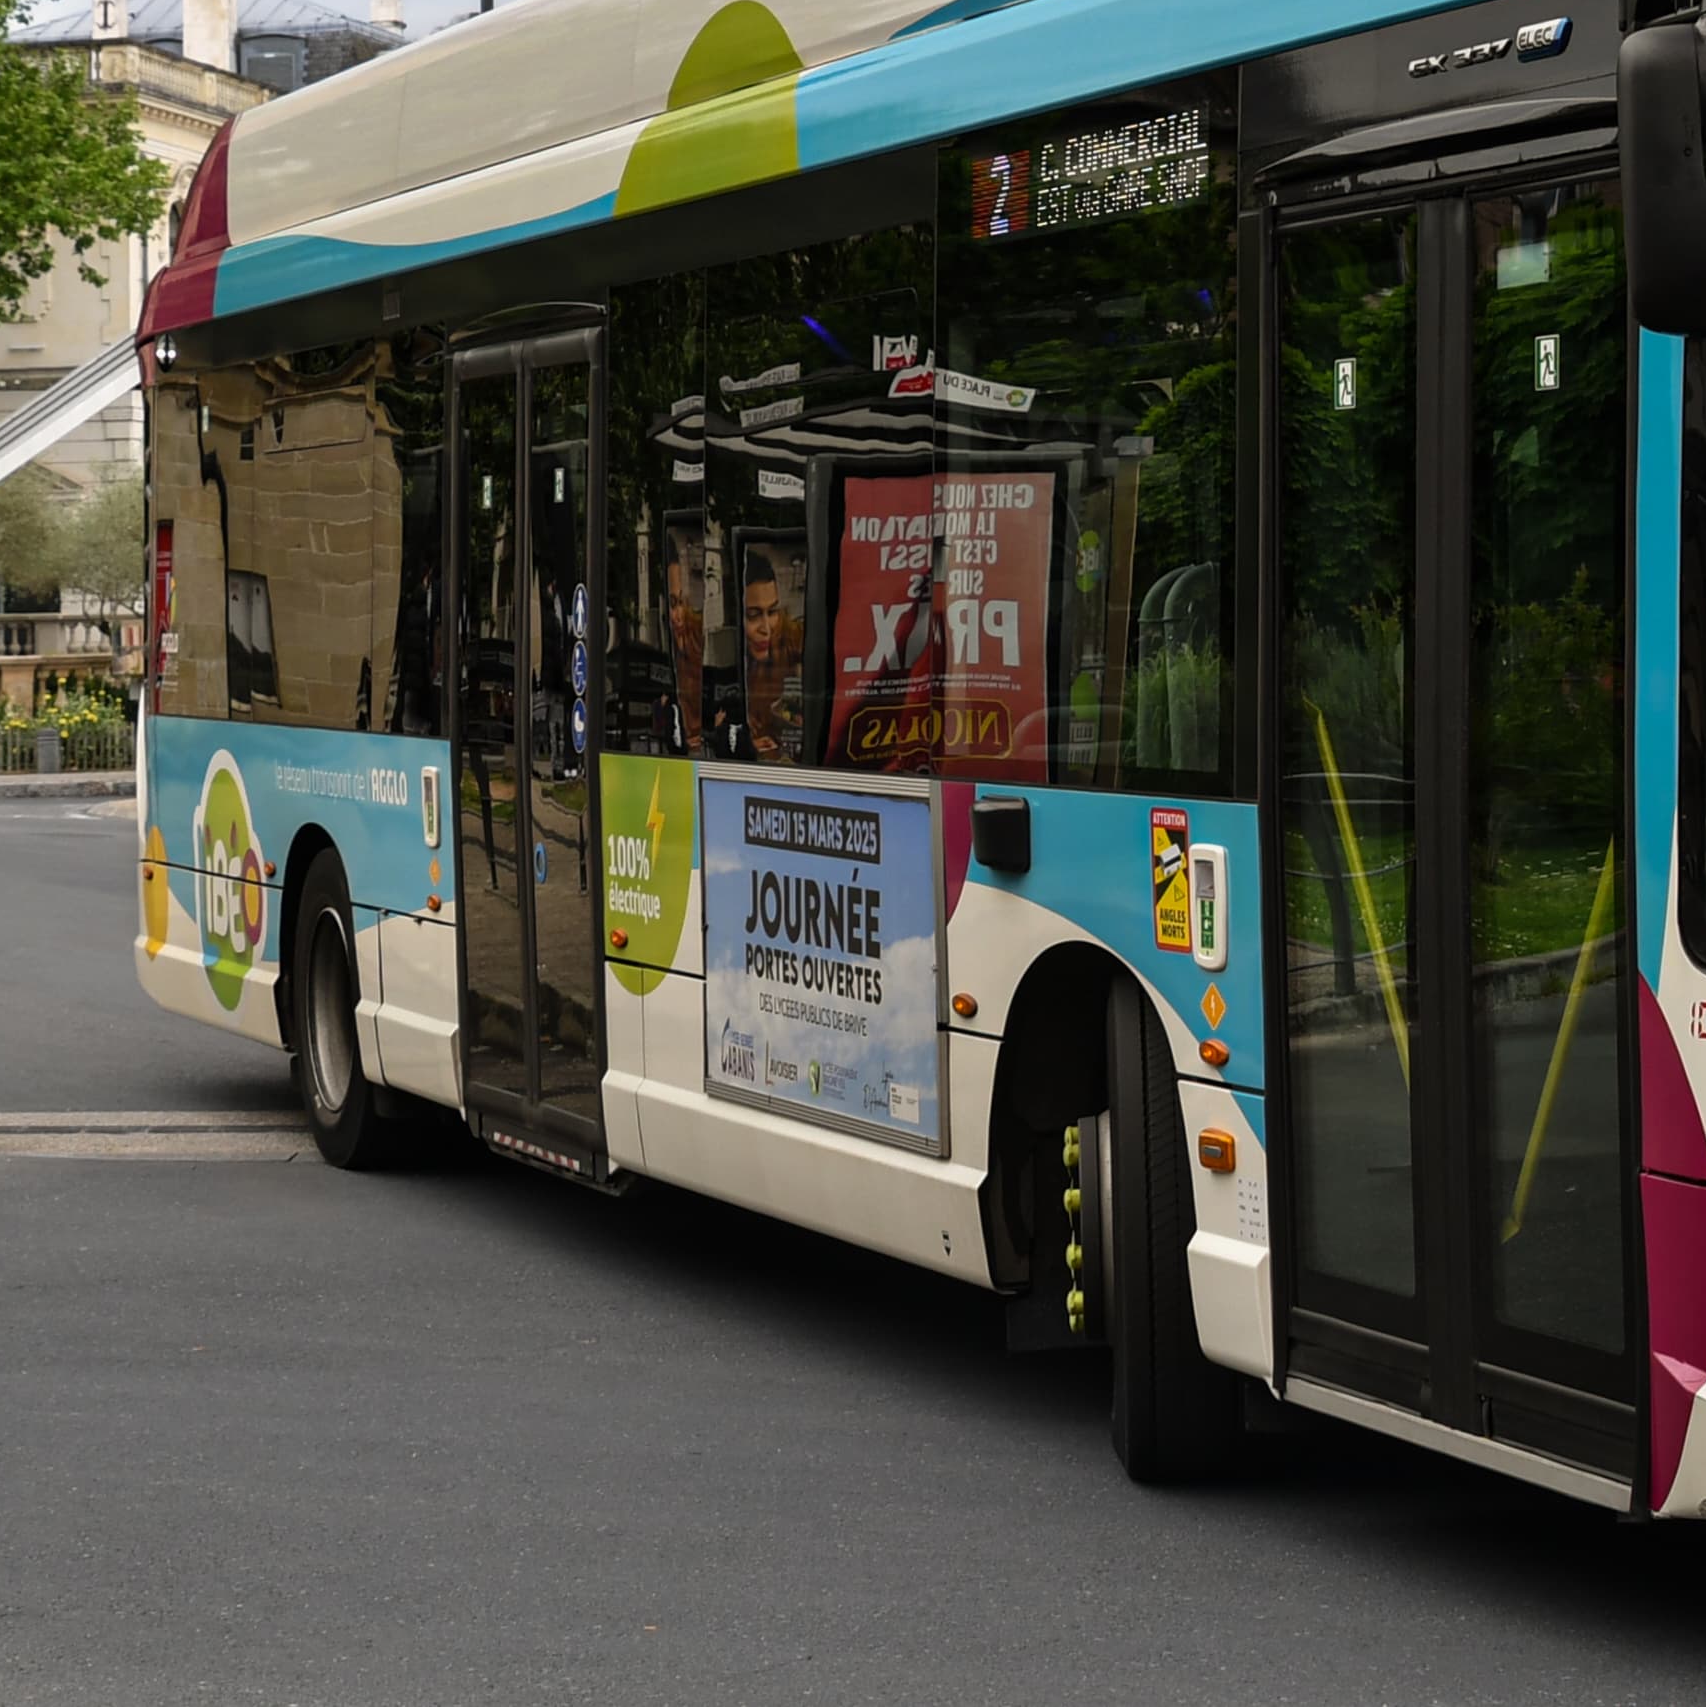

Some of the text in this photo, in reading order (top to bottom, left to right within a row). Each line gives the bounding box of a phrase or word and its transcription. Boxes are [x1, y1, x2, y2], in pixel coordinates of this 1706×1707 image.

[1408, 37, 1513, 78] GX 337
[1518, 26, 1552, 48] ELEC
[1064, 109, 1207, 176] COMMERCIAL
[990, 155, 1011, 236] 2
[1037, 155, 1209, 227] EST via GARE SNCF
[748, 805, 878, 856] SAMEDI 15 MARS 2025
[1153, 811, 1186, 827] ATTENTION
[608, 833, 650, 881] 100%
[609, 880, 661, 925] électrique
[745, 867, 881, 959] JOURNÉE
[1159, 907, 1186, 924] ANGLES
[1161, 923, 1186, 940] MORTS
[745, 942, 883, 1006] PORTES OUVERTES
[759, 992, 868, 1038] DES LYCÉES PUBLICS DE BRIVE
